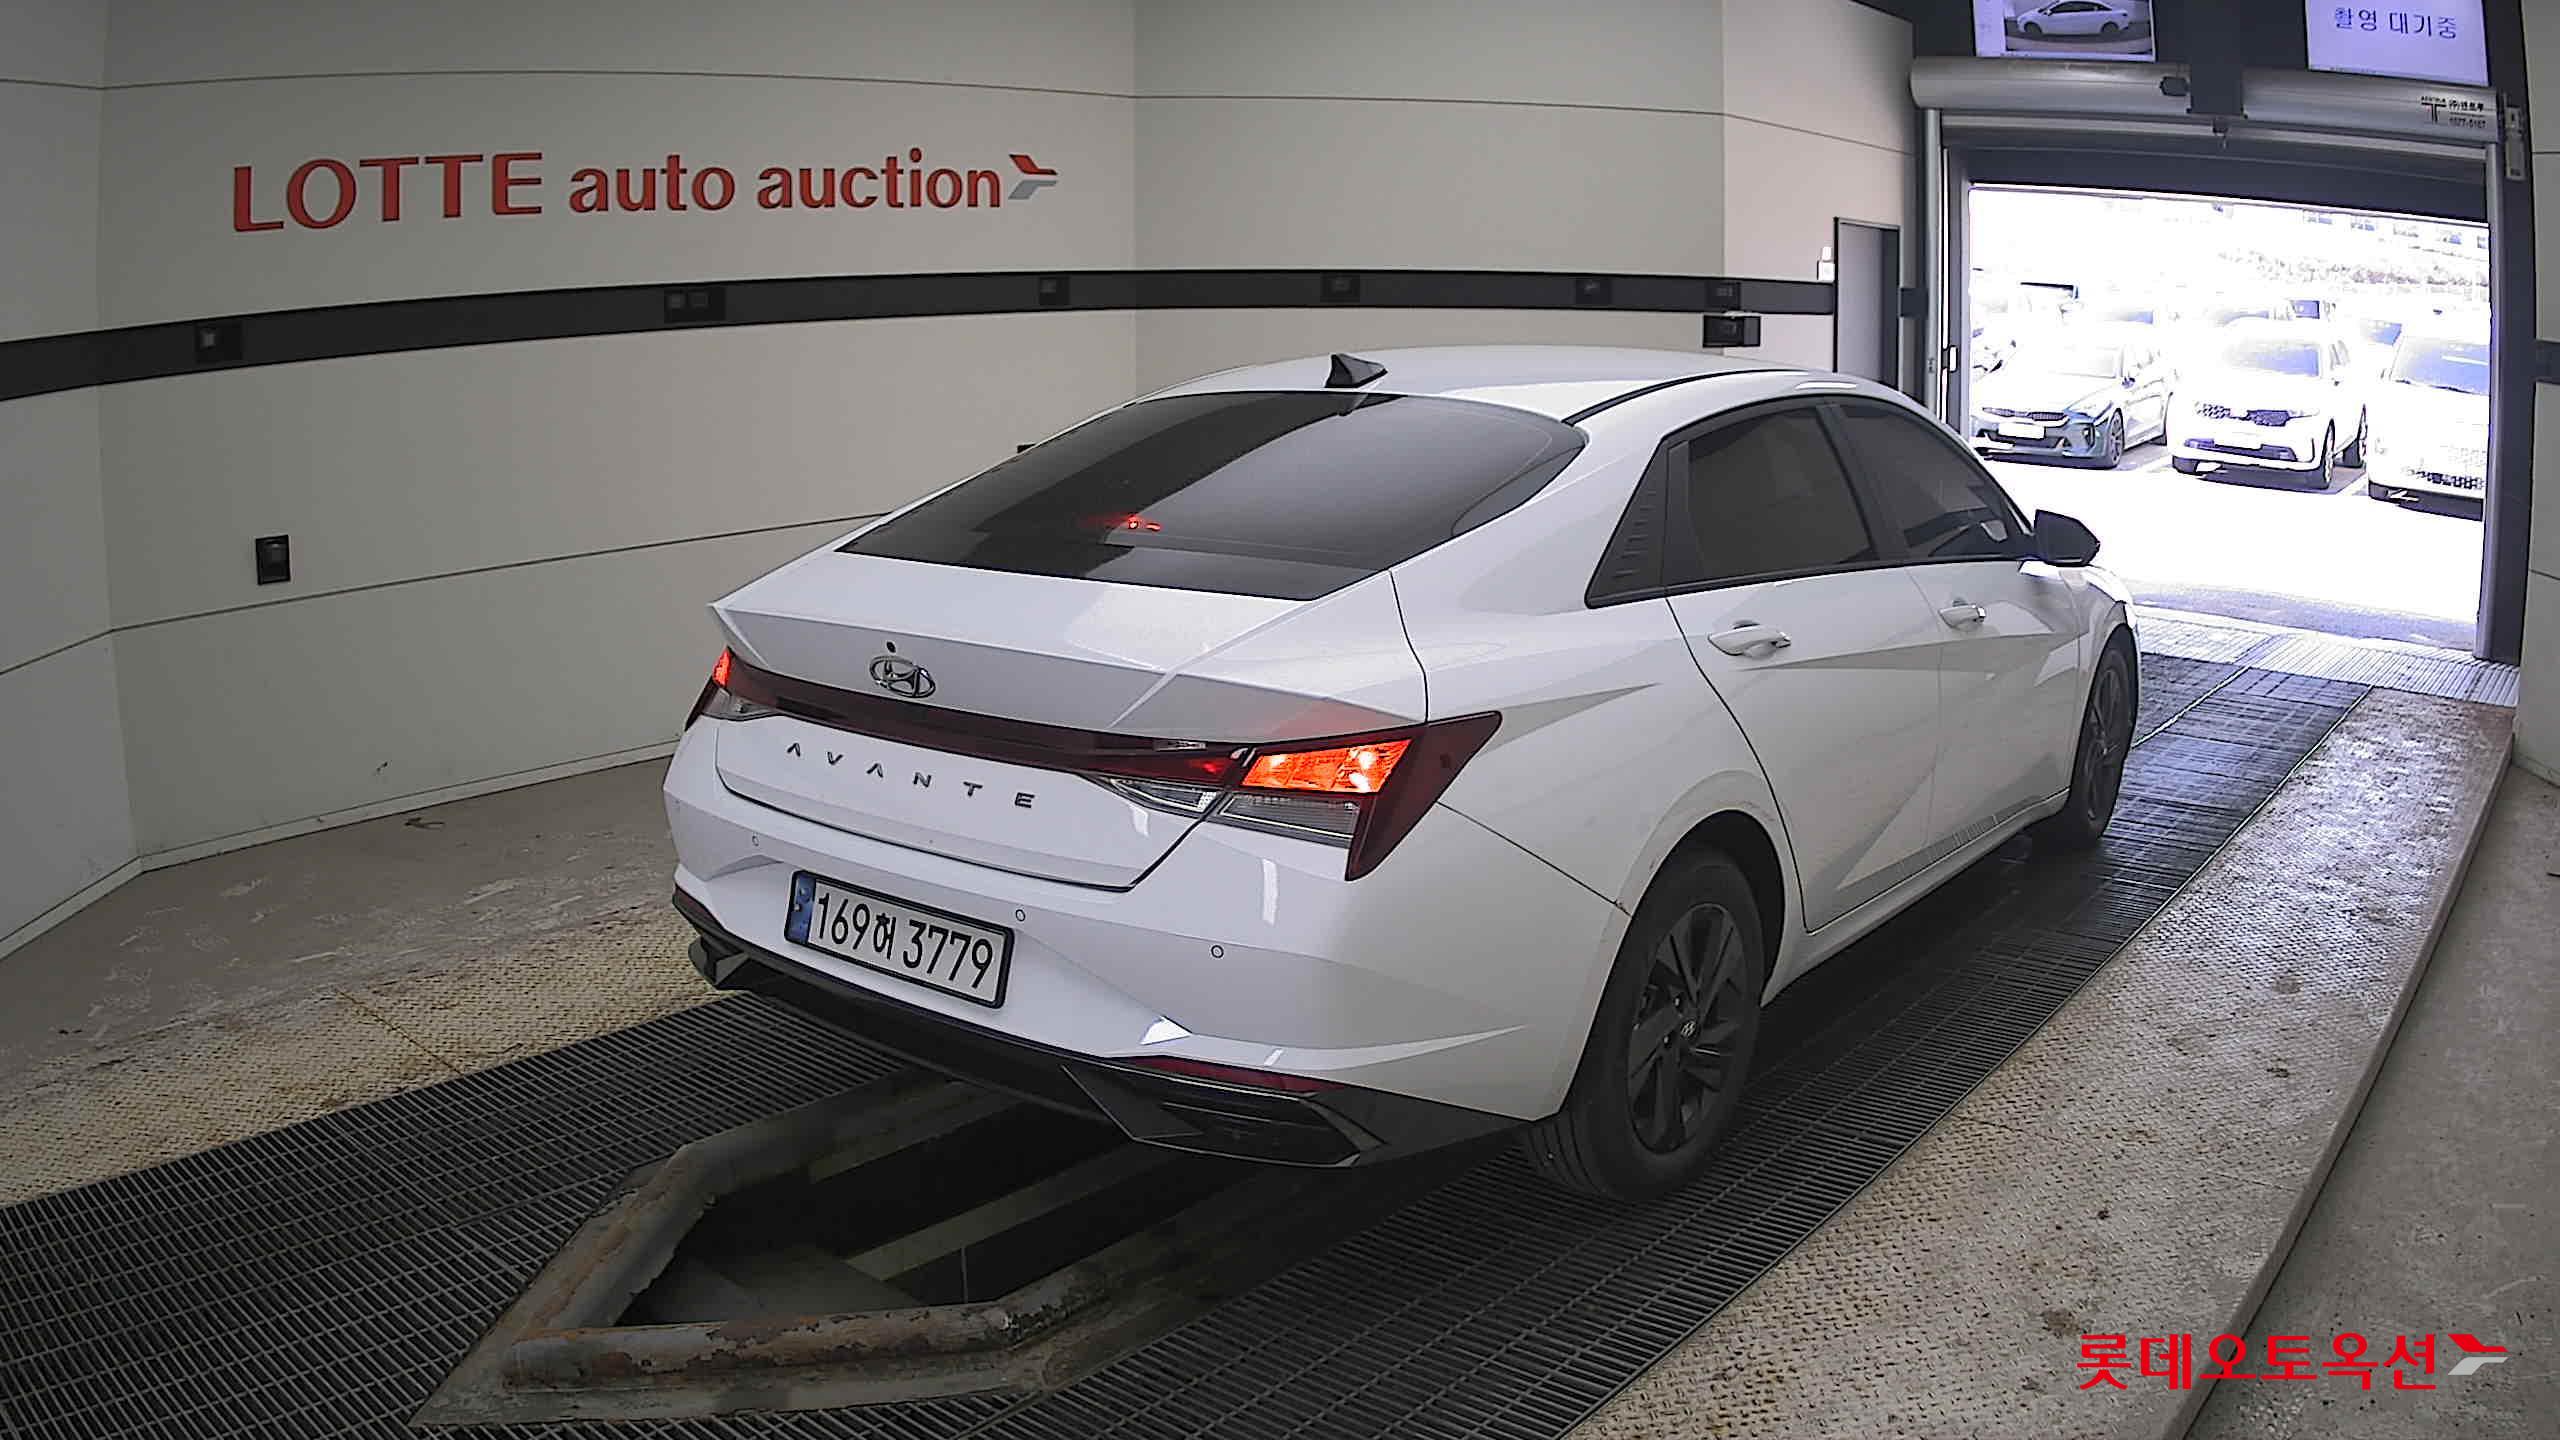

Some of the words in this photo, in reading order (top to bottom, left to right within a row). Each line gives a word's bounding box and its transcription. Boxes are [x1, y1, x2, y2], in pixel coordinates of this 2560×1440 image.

[2335, 8, 2377, 31] 촬영
[2389, 12, 2457, 39] 대기중
[234, 153, 542, 232] LOTTE
[570, 155, 735, 212] auto
[759, 149, 1001, 208] auction
[787, 742, 1035, 808] AVANTE
[818, 893, 896, 960] 169허
[903, 919, 993, 989] 3779
